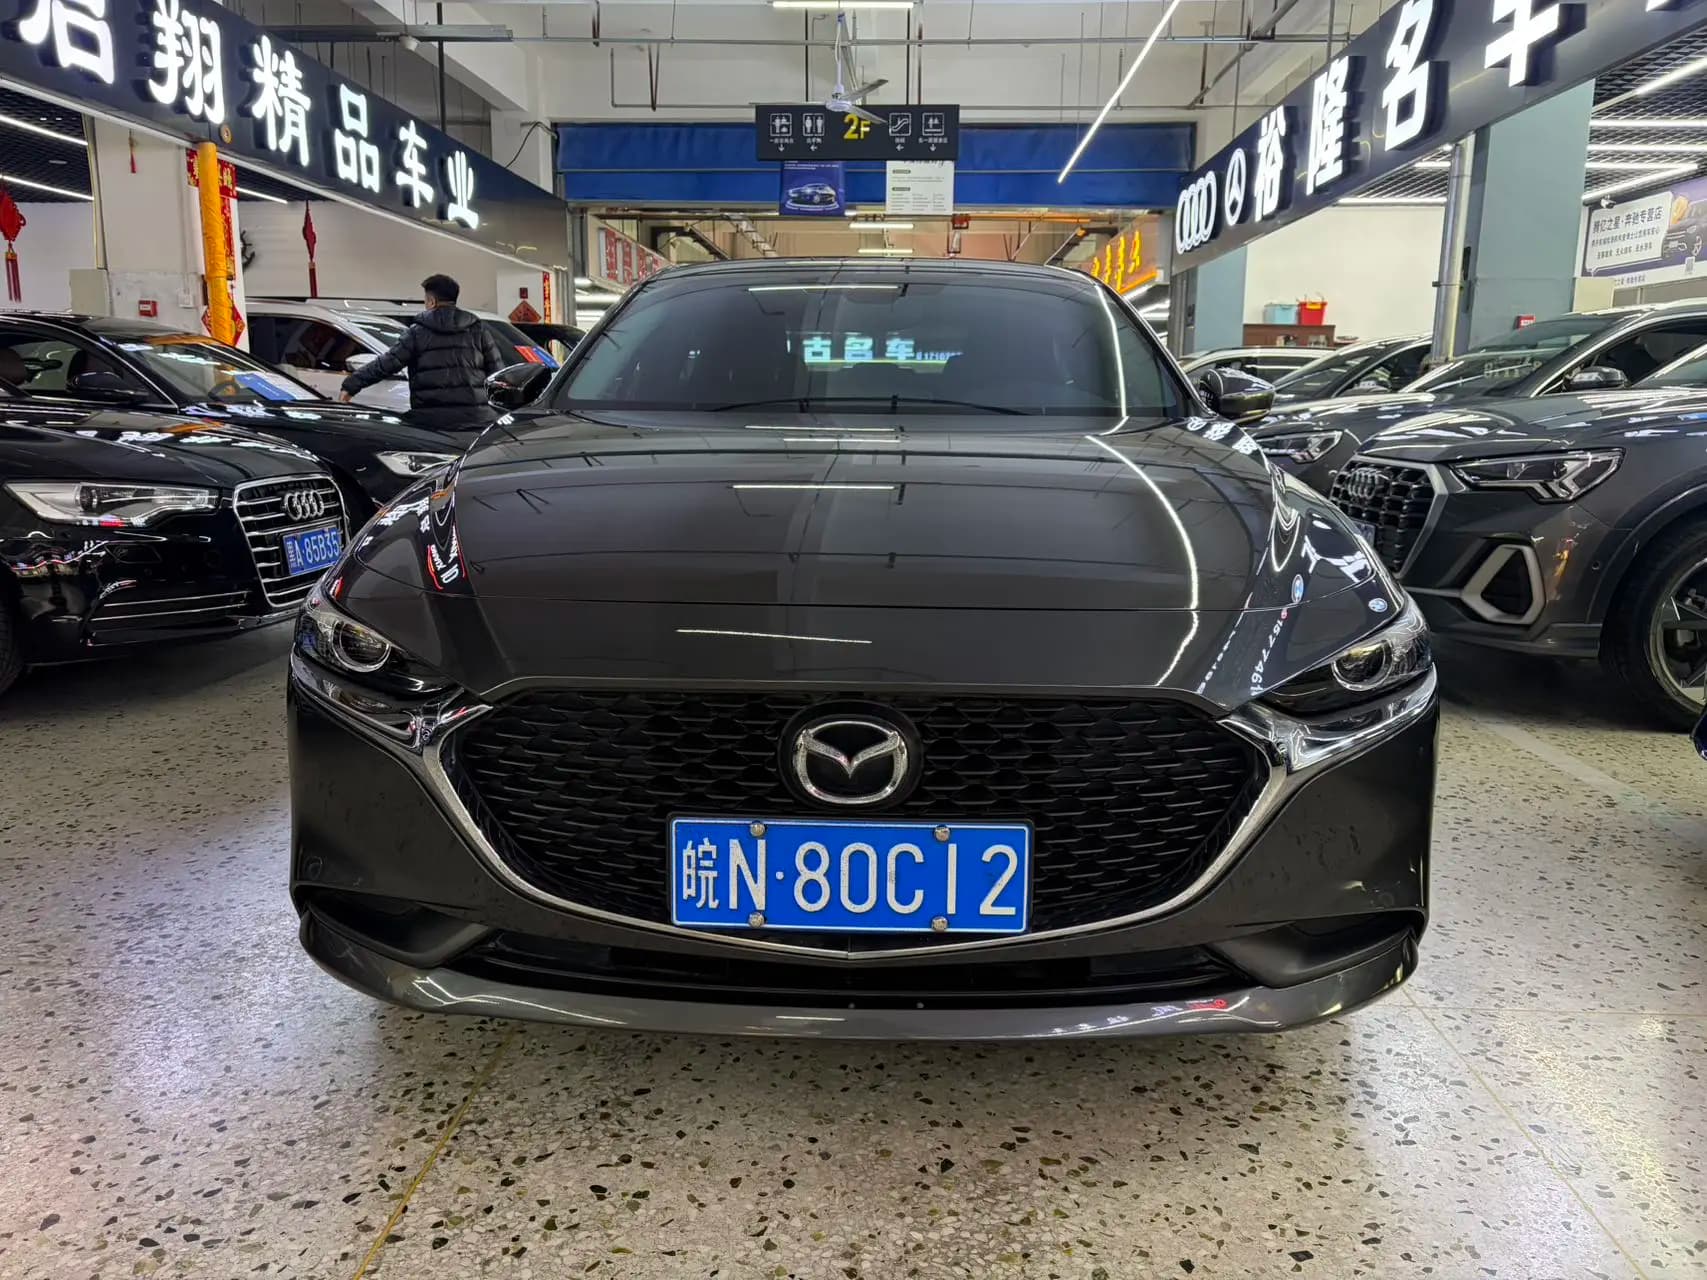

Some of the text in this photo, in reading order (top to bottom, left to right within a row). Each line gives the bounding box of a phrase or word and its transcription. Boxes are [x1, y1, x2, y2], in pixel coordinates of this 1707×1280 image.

[843, 113, 871, 140] 2F
[1254, 0, 1669, 222] 裕隆名车
[682, 837, 1018, 917] 皖N·80C12
